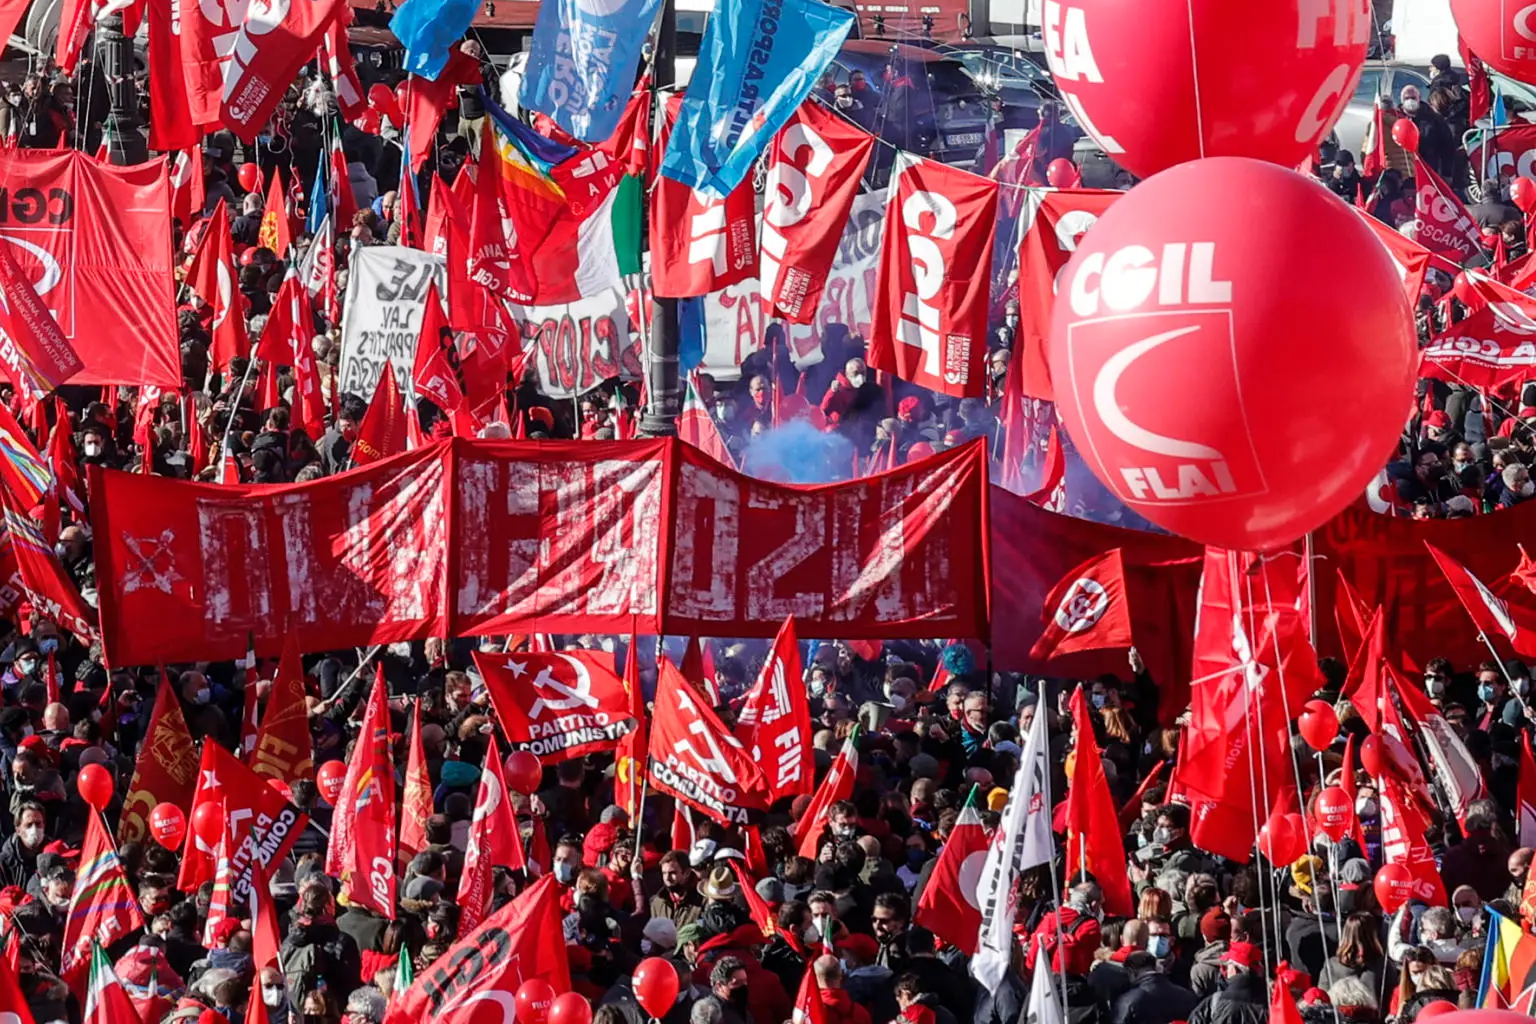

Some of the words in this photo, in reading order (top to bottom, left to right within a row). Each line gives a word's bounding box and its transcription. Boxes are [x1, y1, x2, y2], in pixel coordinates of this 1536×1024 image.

[1414, 217, 1470, 255] OSCANA
[1070, 241, 1232, 317] CGIL
[1120, 461, 1237, 499] FLAI
[519, 720, 631, 756] COMUNISTA
[528, 712, 609, 740] PARTITO
